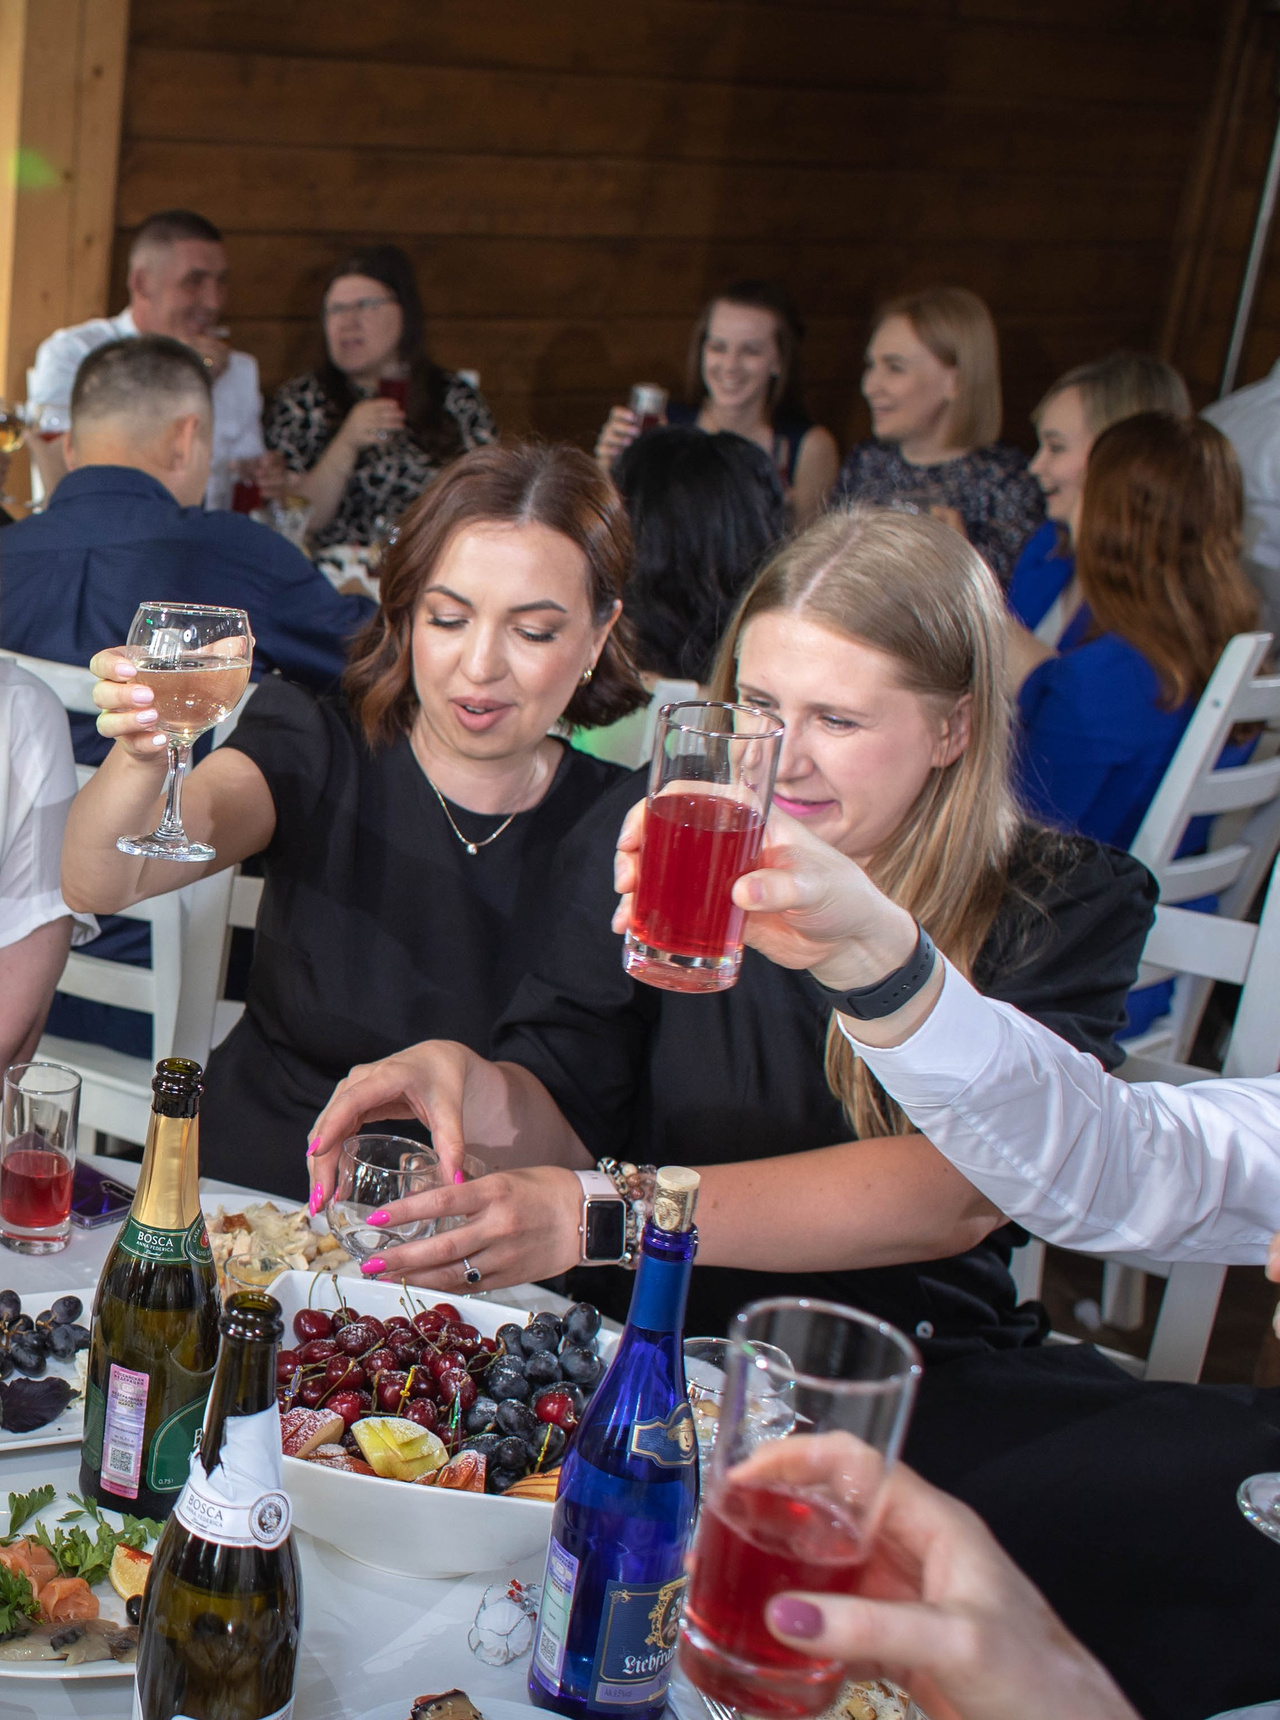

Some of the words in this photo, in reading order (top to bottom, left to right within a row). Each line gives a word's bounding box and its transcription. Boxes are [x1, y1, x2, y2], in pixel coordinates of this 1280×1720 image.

[135, 1240, 149, 1249] ANNA
[149, 1244, 174, 1253] FEDERICA
[137, 1231, 174, 1247] BOSCA
[187, 1494, 224, 1521] BOSCA
[197, 1513, 223, 1528] FEDERICA
